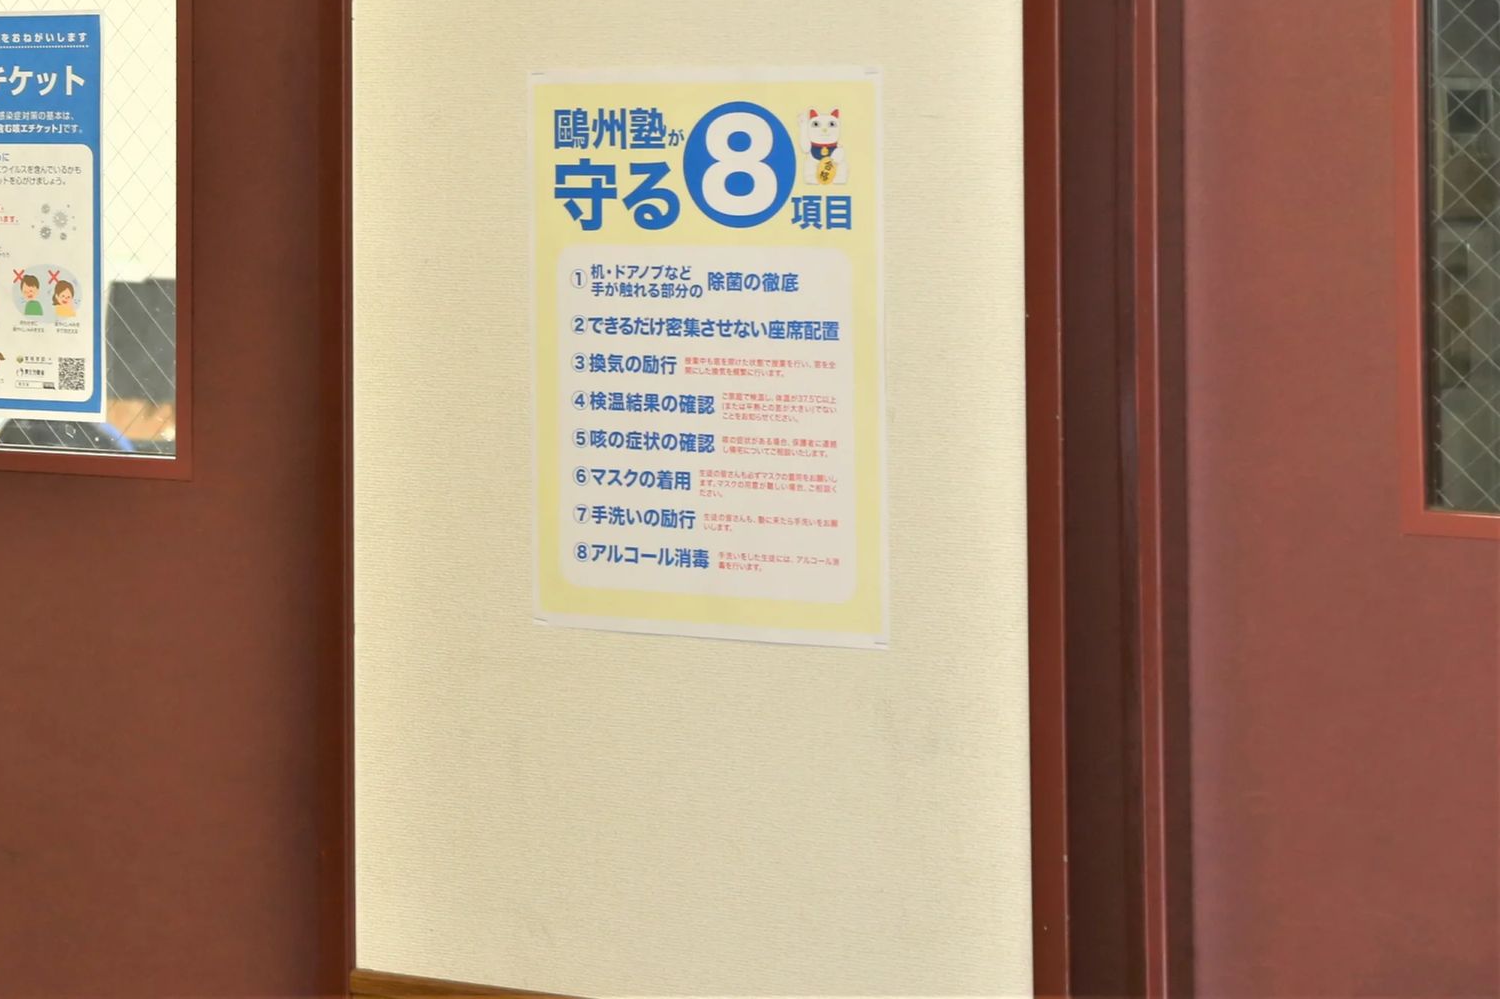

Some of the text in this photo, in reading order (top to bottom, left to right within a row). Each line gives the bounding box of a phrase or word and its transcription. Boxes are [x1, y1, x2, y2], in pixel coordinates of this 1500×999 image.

[554, 111, 852, 231] 守る 8 項目
[590, 264, 692, 281] 机・ドアノブなど
[590, 282, 703, 299] 手が触れる部分の
[707, 272, 799, 293] 除菌の徹底
